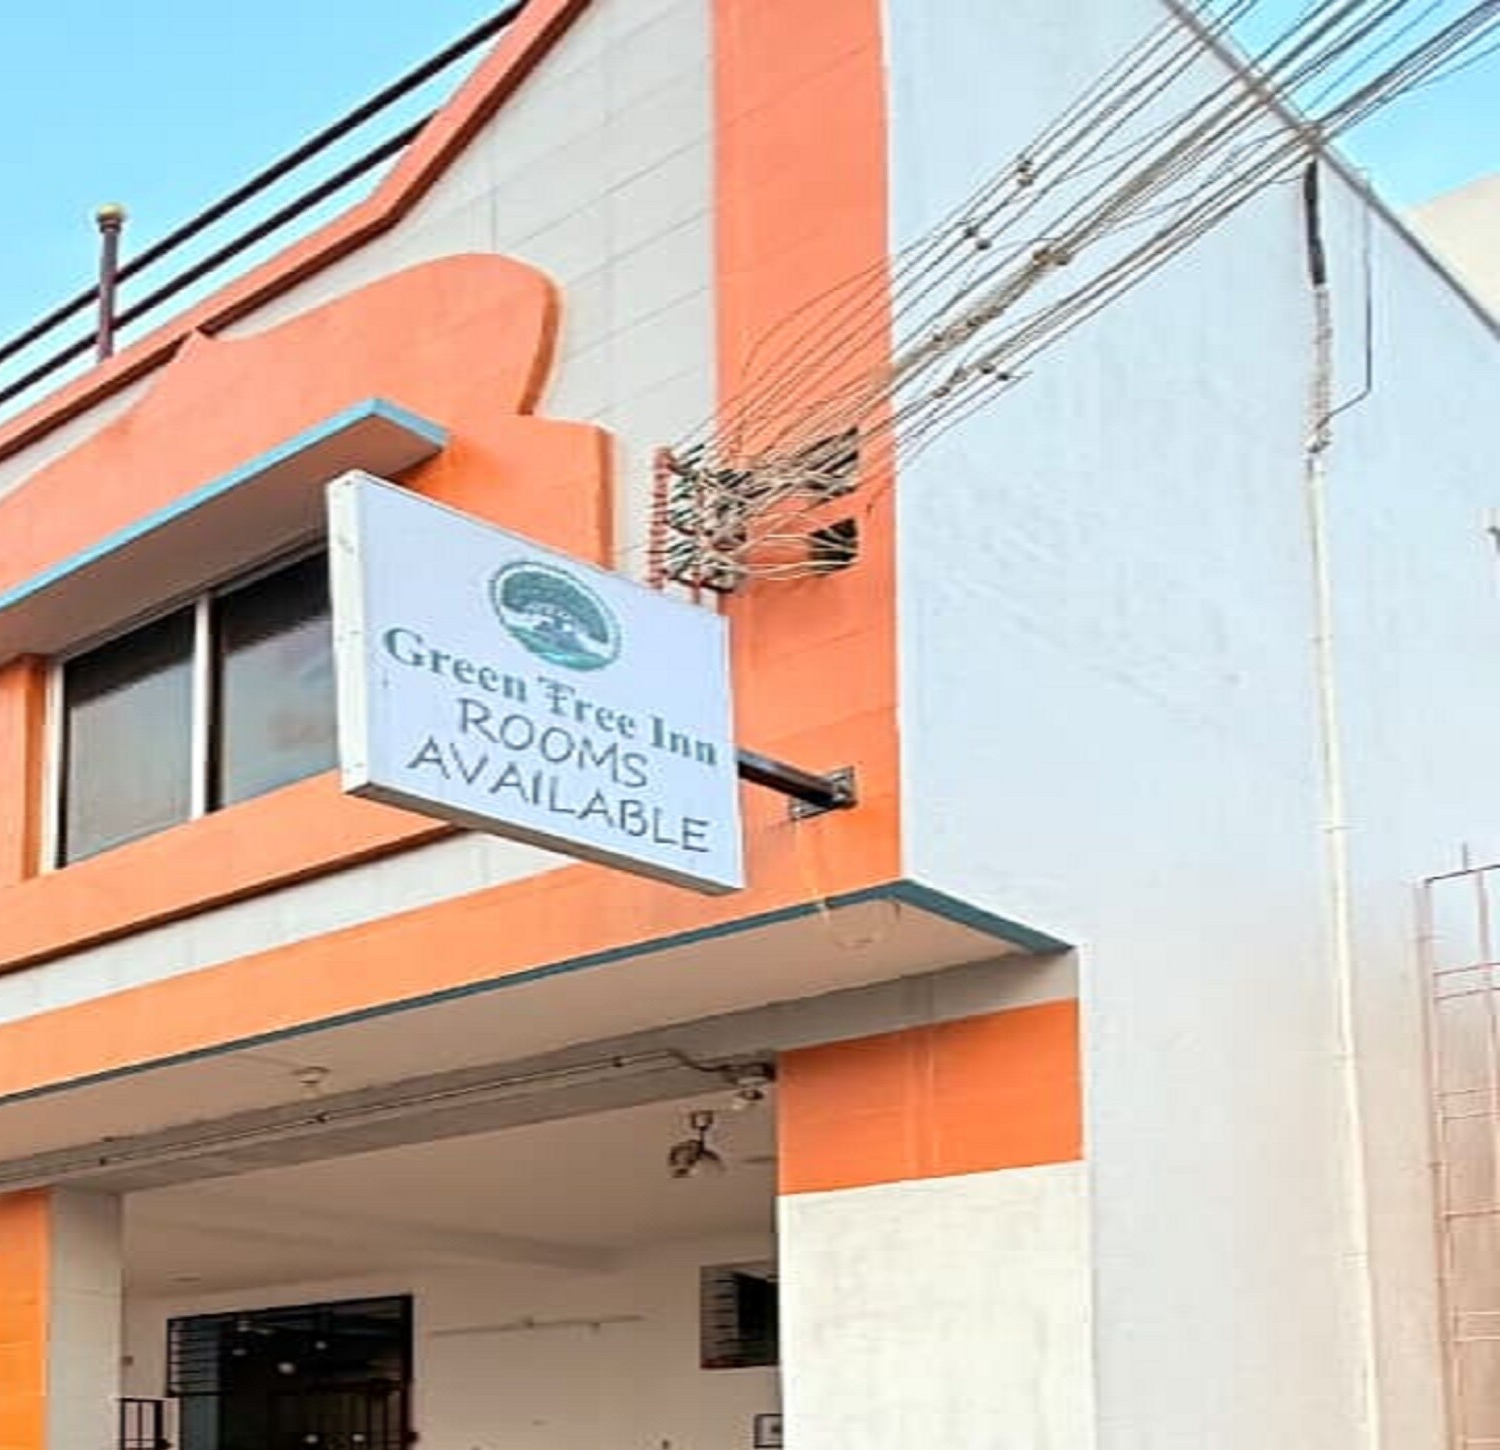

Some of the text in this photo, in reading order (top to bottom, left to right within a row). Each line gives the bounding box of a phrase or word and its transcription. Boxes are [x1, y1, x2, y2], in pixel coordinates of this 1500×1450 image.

[383, 626, 718, 767] Green Tree Inn
[459, 697, 650, 789] ROOMS
[406, 735, 710, 853] AVAILABLE
